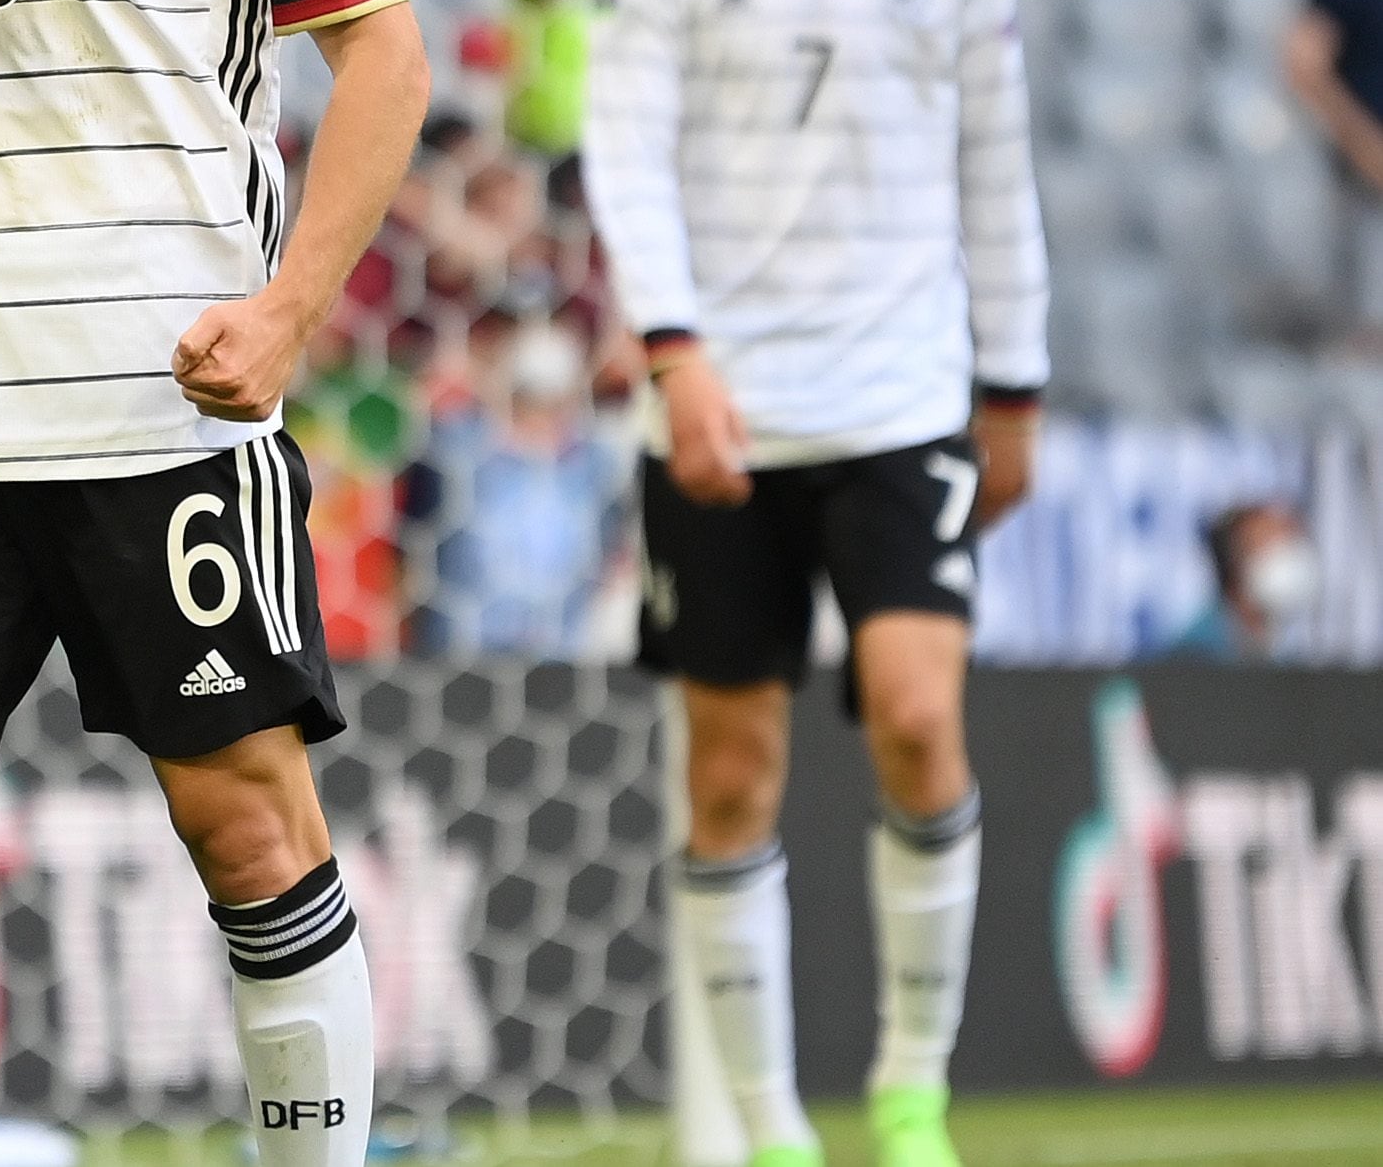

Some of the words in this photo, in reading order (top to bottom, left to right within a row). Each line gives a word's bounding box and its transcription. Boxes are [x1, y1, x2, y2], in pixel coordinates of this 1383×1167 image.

[794, 36, 836, 128] 7
[923, 450, 979, 544] 7
[167, 493, 242, 627] 6
[179, 676, 246, 696] adidas
[260, 1097, 346, 1131] DFB
